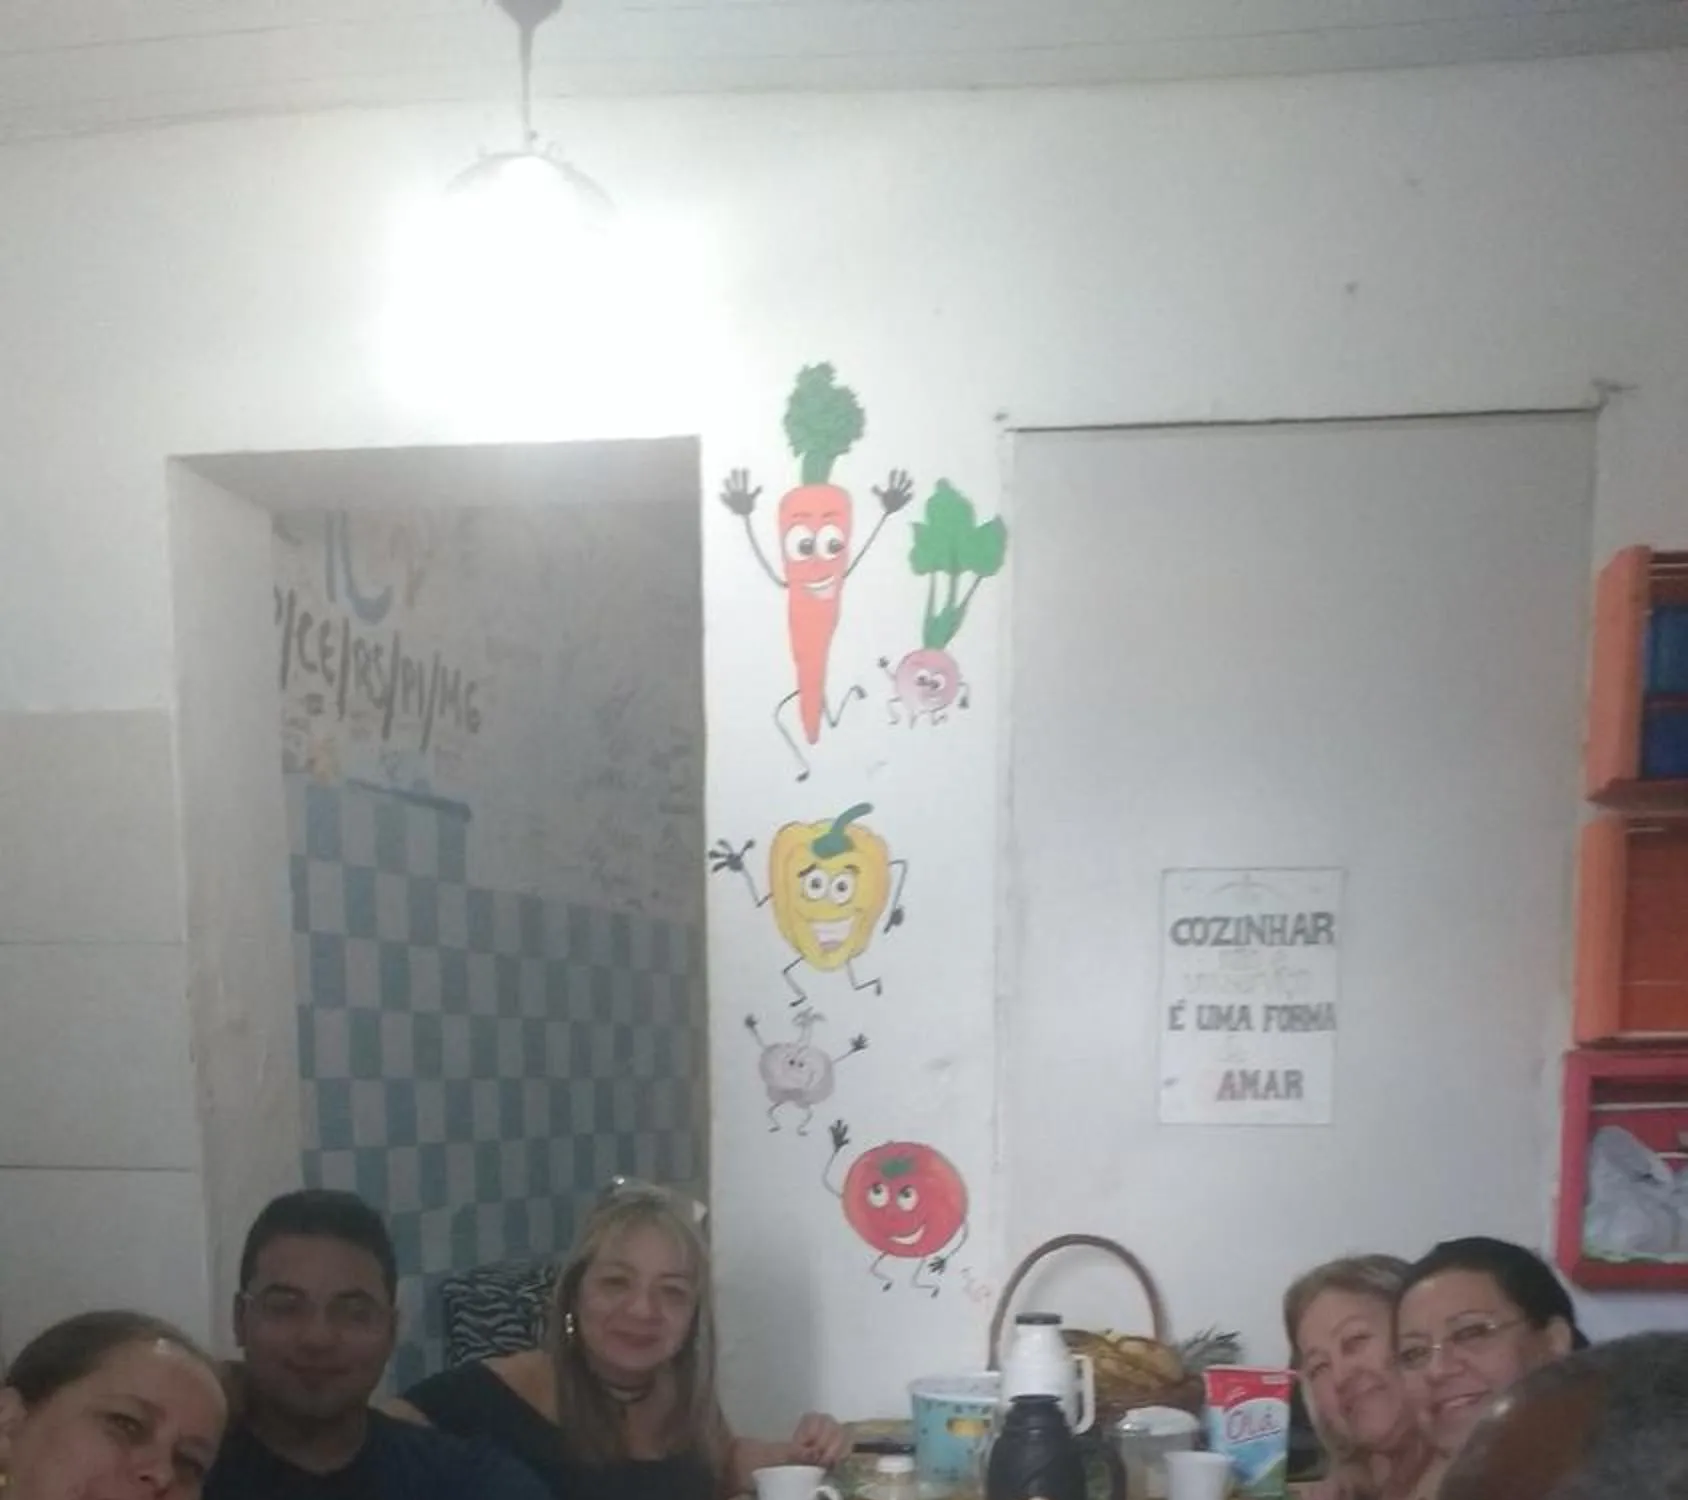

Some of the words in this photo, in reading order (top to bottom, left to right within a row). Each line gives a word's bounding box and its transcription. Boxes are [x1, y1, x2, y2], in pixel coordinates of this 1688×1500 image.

[1168, 911, 1335, 947] COZINHAR
[1167, 998, 1187, 1031] É
[1196, 1004, 1253, 1032] UMA
[1262, 1002, 1338, 1033] FORMA
[1215, 1068, 1305, 1102] AMAR
